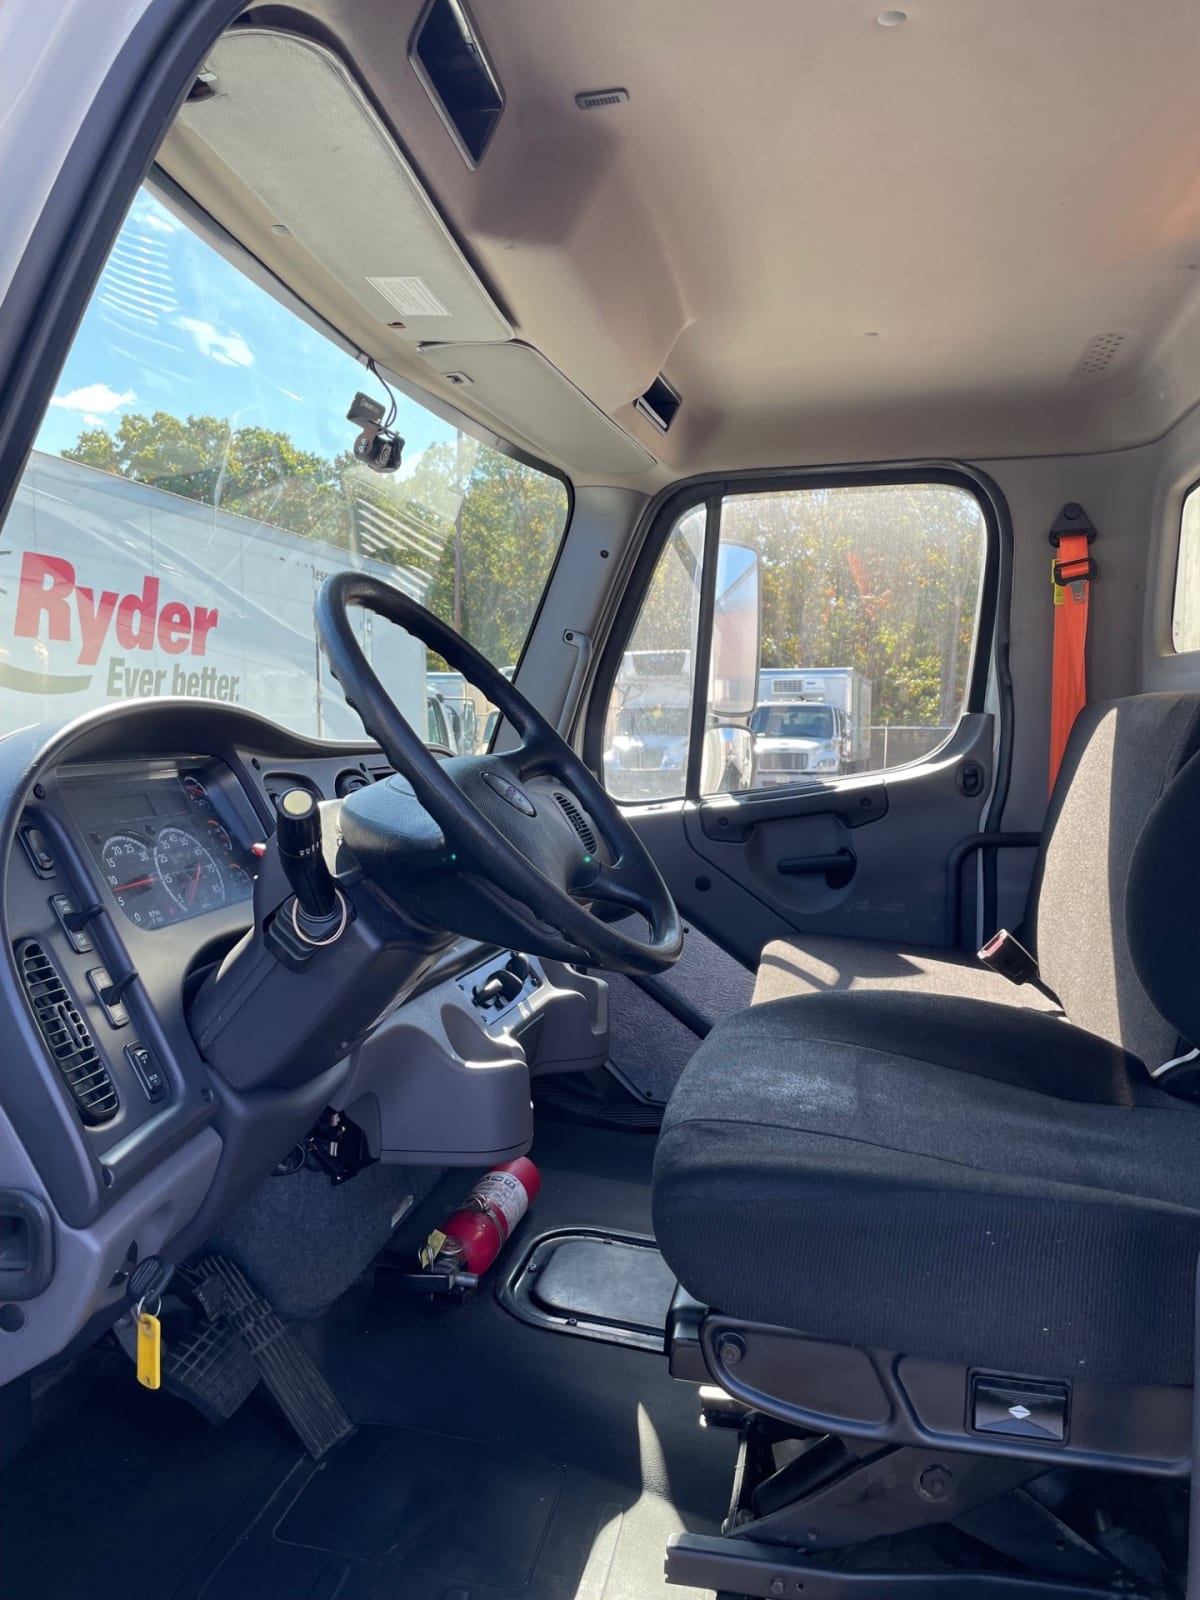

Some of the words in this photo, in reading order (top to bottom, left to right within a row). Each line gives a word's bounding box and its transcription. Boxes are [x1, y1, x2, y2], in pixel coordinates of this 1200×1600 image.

[14, 551, 219, 665] Ryder
[106, 657, 166, 697] Ever
[172, 664, 240, 702] better.
[112, 845, 122, 856] 20
[124, 843, 134, 854] 25
[106, 858, 116, 868] 15
[158, 853, 168, 863] 25
[108, 875, 117, 885] 10
[118, 896, 125, 907] 5
[134, 912, 141, 922] 0
